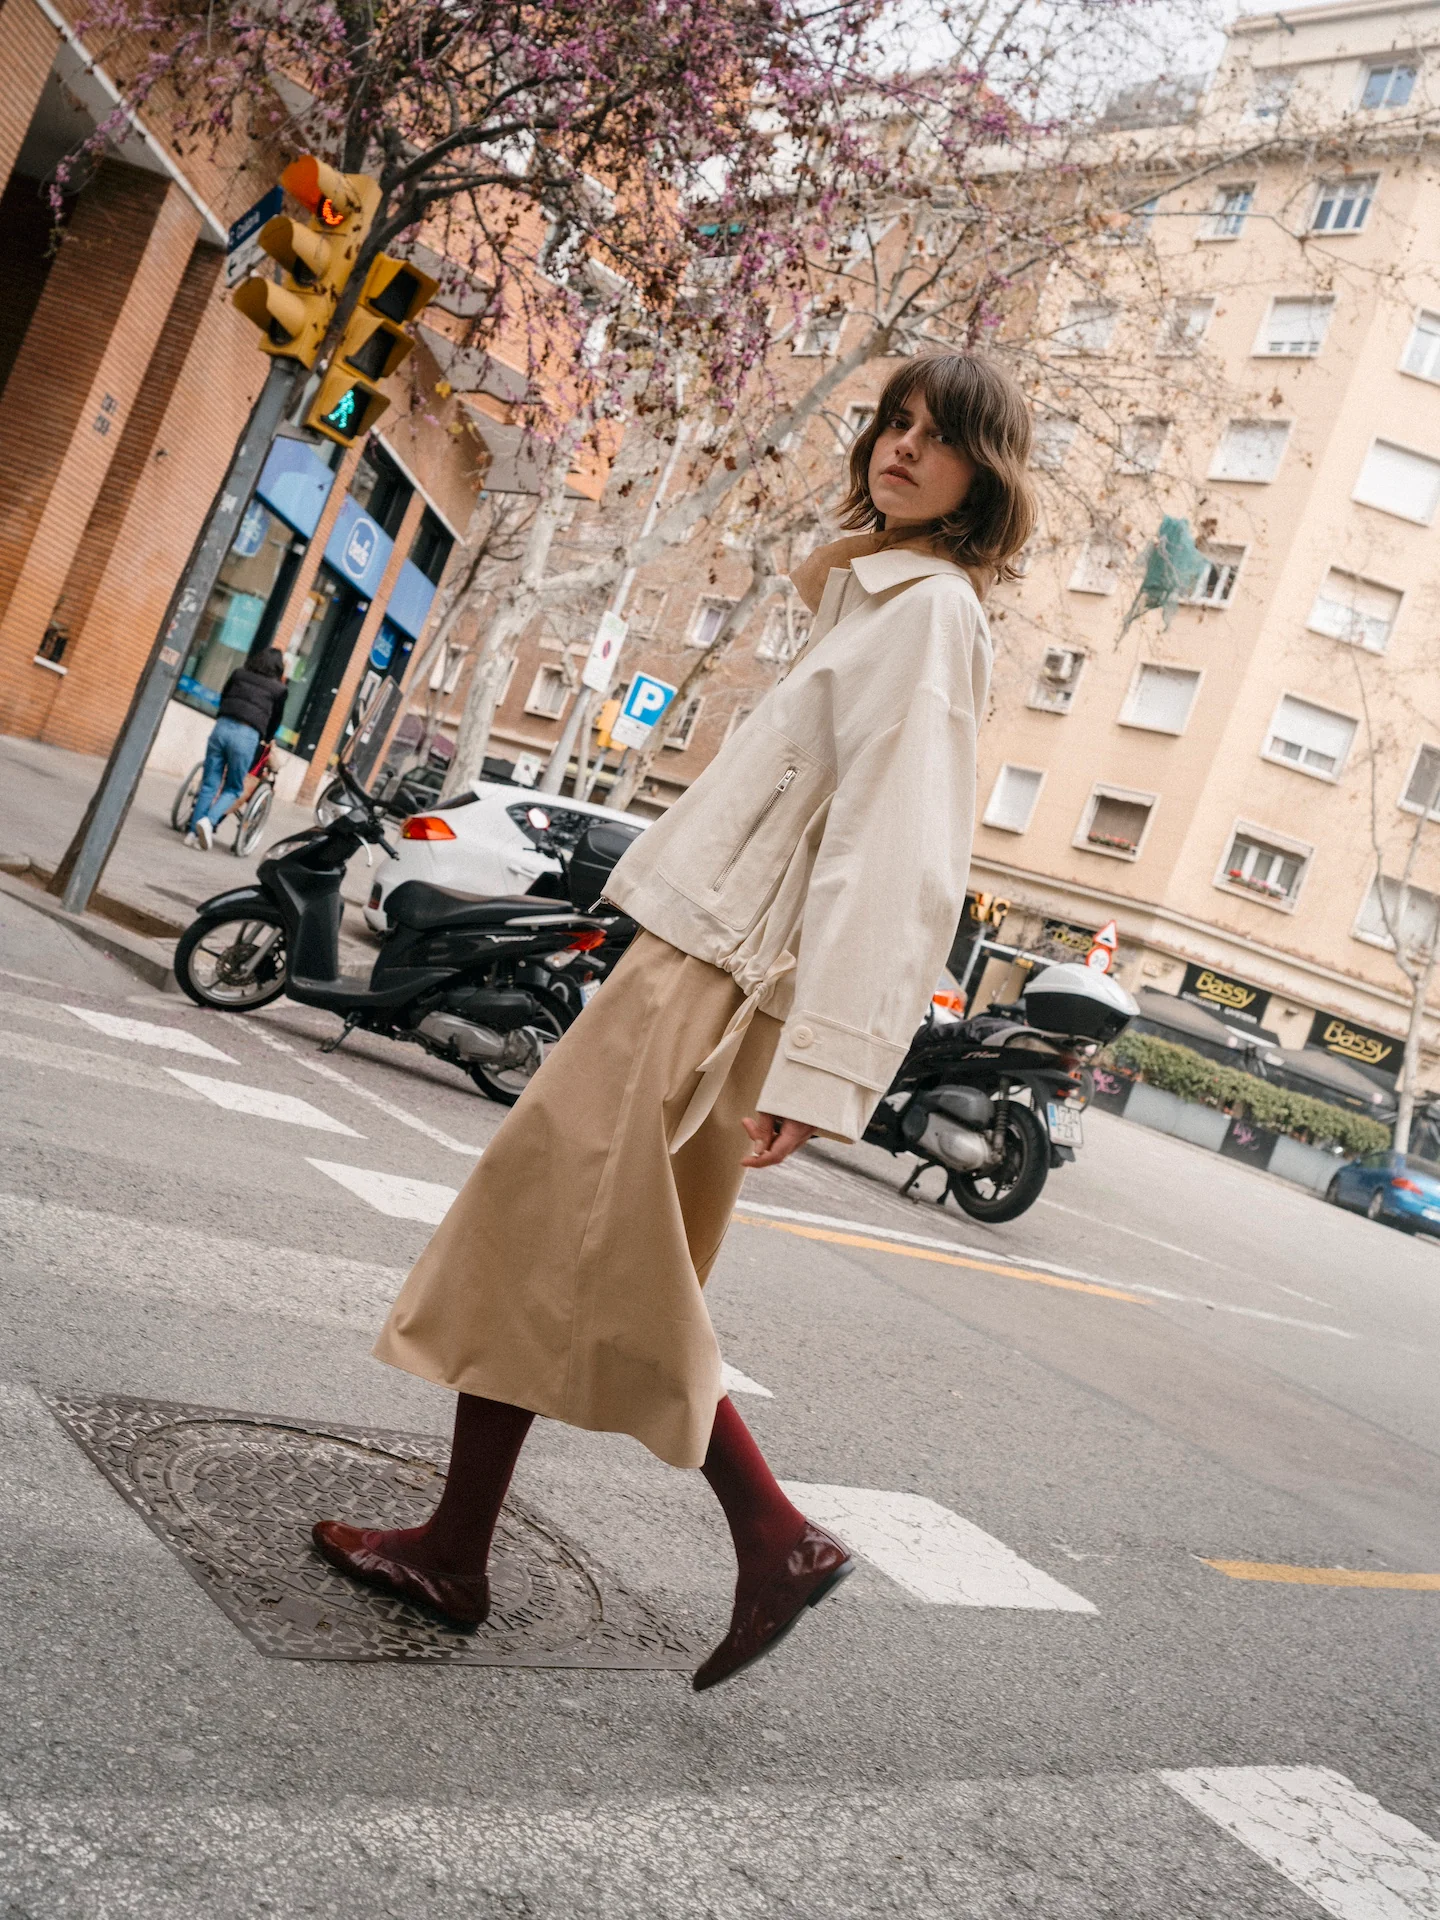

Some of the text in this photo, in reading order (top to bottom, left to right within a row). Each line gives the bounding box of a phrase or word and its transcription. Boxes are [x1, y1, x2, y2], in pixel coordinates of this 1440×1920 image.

[630, 681, 666, 718] P
[1195, 970, 1257, 1010] Bassy
[1323, 1020, 1393, 1065] Bassy
